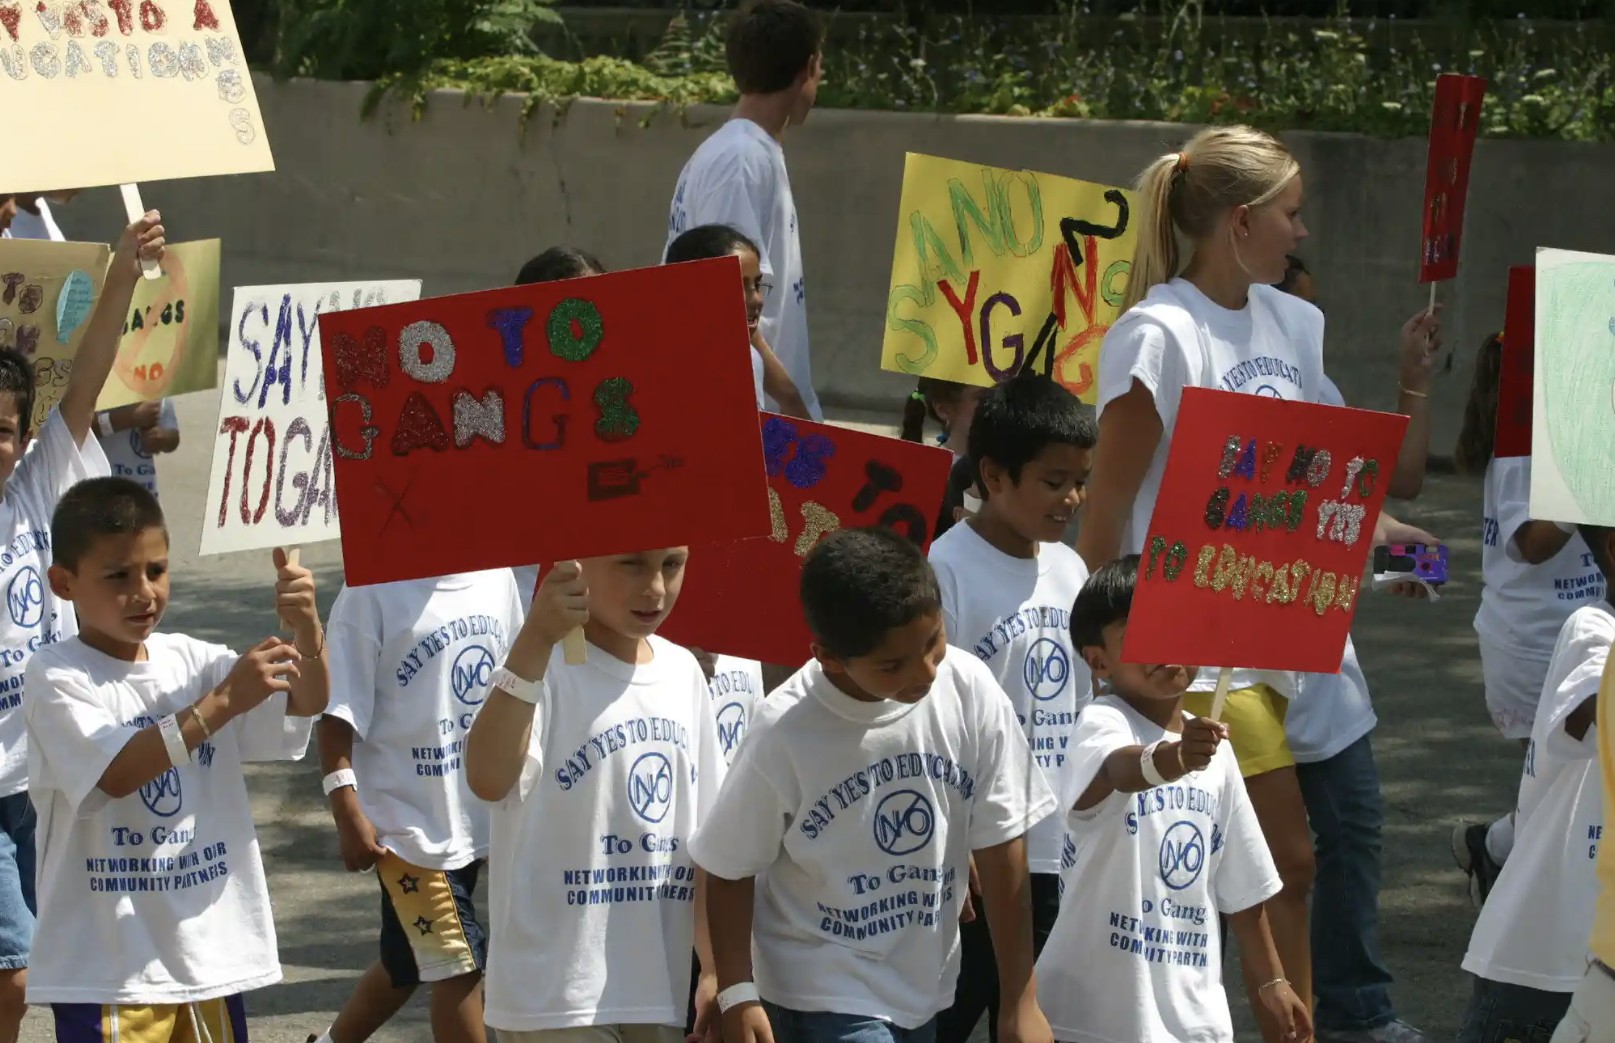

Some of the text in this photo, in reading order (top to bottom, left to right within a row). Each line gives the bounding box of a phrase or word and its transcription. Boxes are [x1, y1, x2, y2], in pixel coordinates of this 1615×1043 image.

[233, 292, 327, 410] SAY
[331, 297, 604, 391] NO TO
[133, 363, 164, 382] NO
[328, 376, 641, 462] GANGS
[218, 415, 338, 528] TO GA
[1217, 434, 1380, 500] SAY NO TO
[1145, 535, 1188, 581] TO
[993, 611, 1026, 645] YES
[1023, 607, 1040, 630] TO
[396, 646, 424, 688] SAY
[418, 625, 451, 659] YES
[450, 618, 468, 641] TO
[1027, 655, 1066, 685] NO
[554, 744, 592, 792] SAY
[588, 723, 627, 760] YES
[625, 718, 648, 744] TO
[632, 770, 671, 806] NO
[800, 795, 836, 840] SAY
[829, 767, 870, 811] YES
[868, 757, 894, 788] TO
[1167, 785, 1184, 811] TO
[111, 826, 144, 847] To
[877, 808, 931, 845] NO
[600, 834, 633, 855] To
[1162, 839, 1202, 873] NO
[86, 857, 174, 874] NETWORKING
[90, 876, 172, 893] COMMUNITY
[848, 873, 882, 896] To
[816, 890, 919, 924] NETWORKING
[820, 908, 914, 942] COMMUNITY
[1176, 930, 1209, 948] WITH
